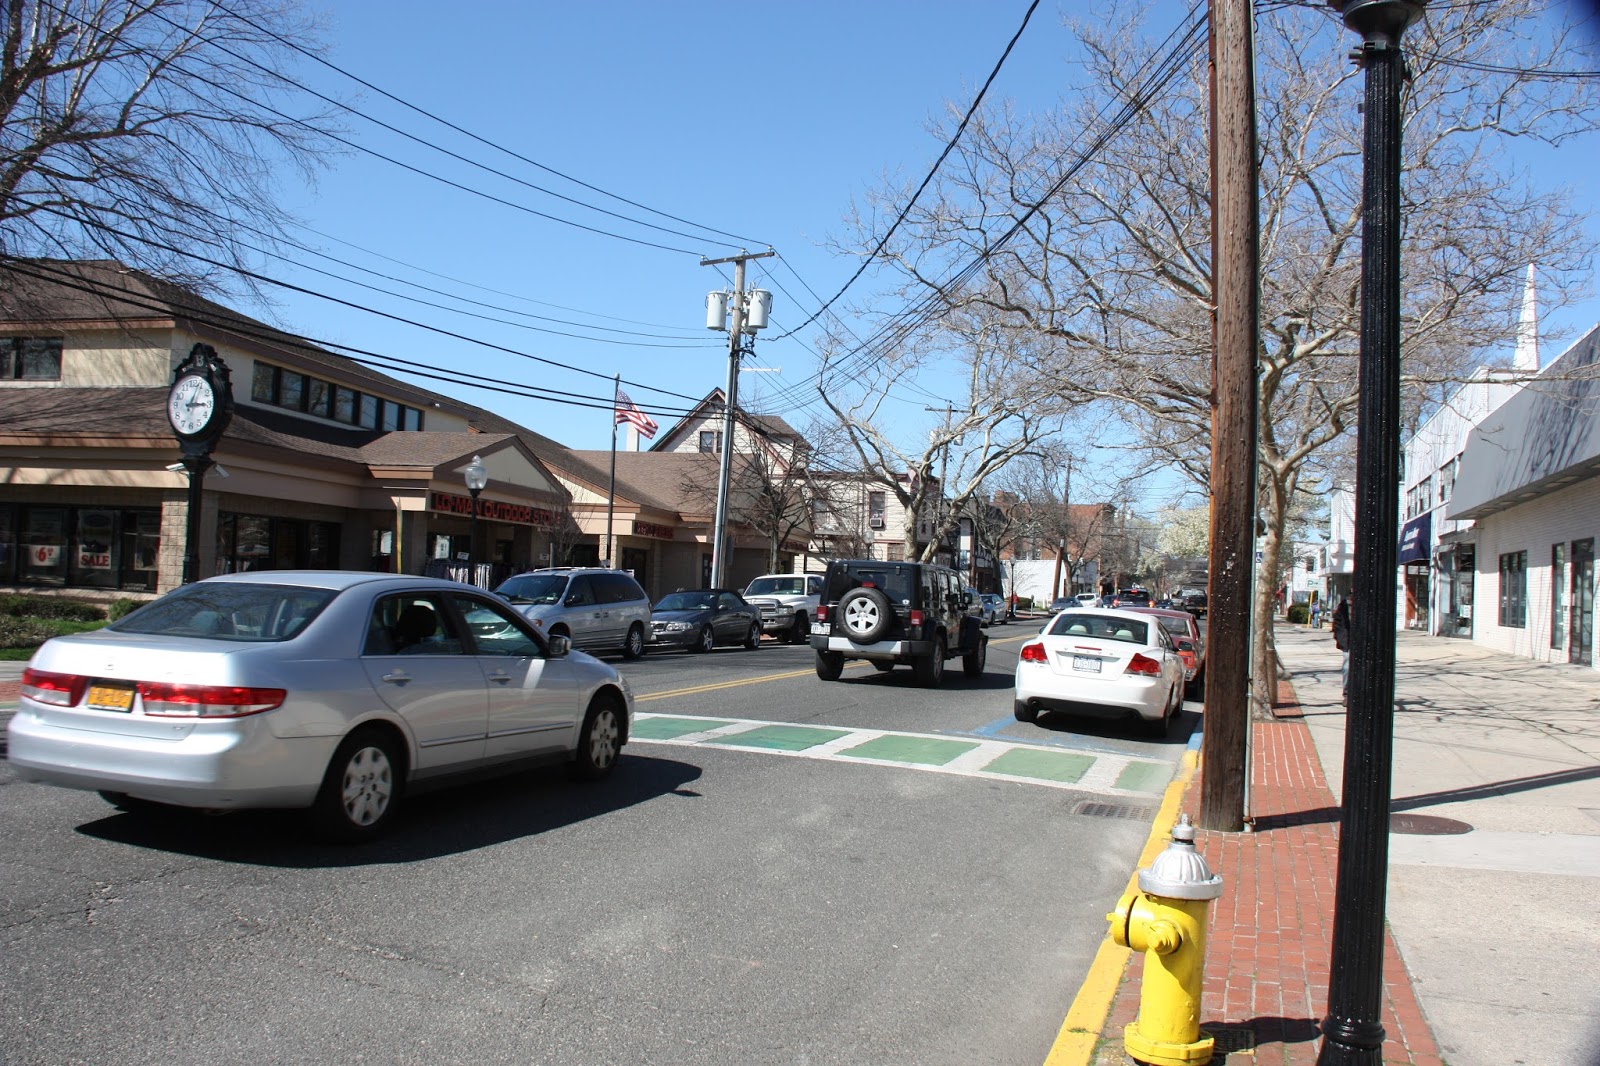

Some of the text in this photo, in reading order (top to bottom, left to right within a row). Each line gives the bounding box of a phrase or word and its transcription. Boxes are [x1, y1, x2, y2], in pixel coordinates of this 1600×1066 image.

[205, 389, 209, 397] 2
[485, 500, 531, 523] OUTDOOR
[81, 555, 110, 567] SALE
